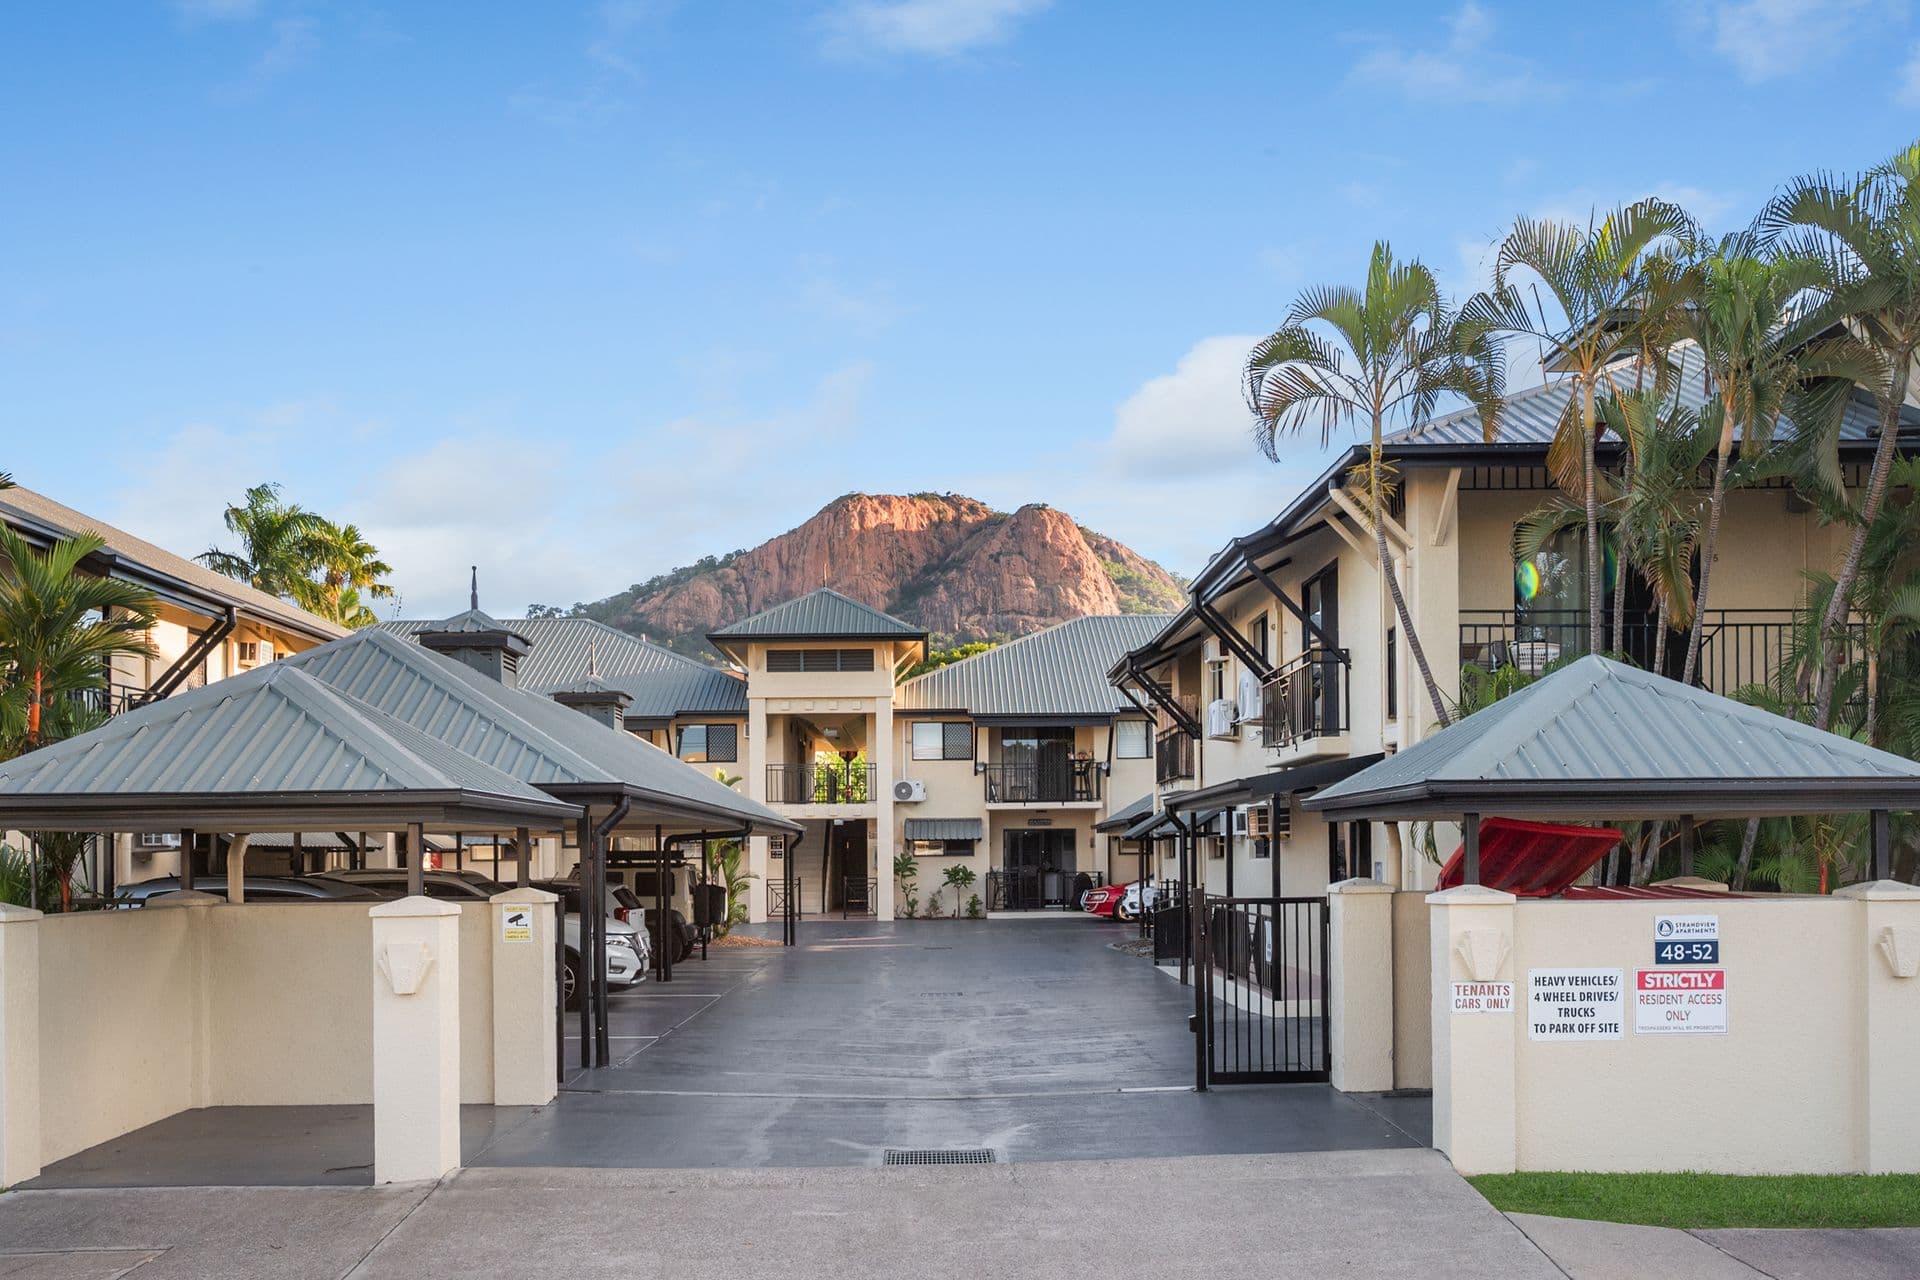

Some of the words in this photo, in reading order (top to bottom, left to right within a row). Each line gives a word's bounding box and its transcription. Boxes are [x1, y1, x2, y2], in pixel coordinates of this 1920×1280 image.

[1661, 944, 1712, 960] 48-52
[1534, 976, 1566, 986] HEAVY
[1568, 976, 1618, 986] VEHICLES/
[1644, 973, 1716, 988] STRICTLY
[1454, 985, 1510, 996] TENANTS
[1534, 993, 1540, 1002] 4
[1543, 992, 1577, 1002] WHEEL
[1579, 991, 1619, 1002] DRIVES/
[1639, 994, 1684, 1005] RESIDENT
[1687, 994, 1722, 1005] ACCESS
[1455, 998, 1481, 1009] CARS
[1486, 998, 1510, 1009] ONLY
[1557, 1007, 1596, 1018] TRUCKS
[1665, 1010, 1691, 1021] ONLY
[1534, 1023, 1546, 1033] TO
[1549, 1023, 1575, 1033] PARK
[1577, 1023, 1596, 1033] OFF
[1598, 1023, 1619, 1033] SITE
